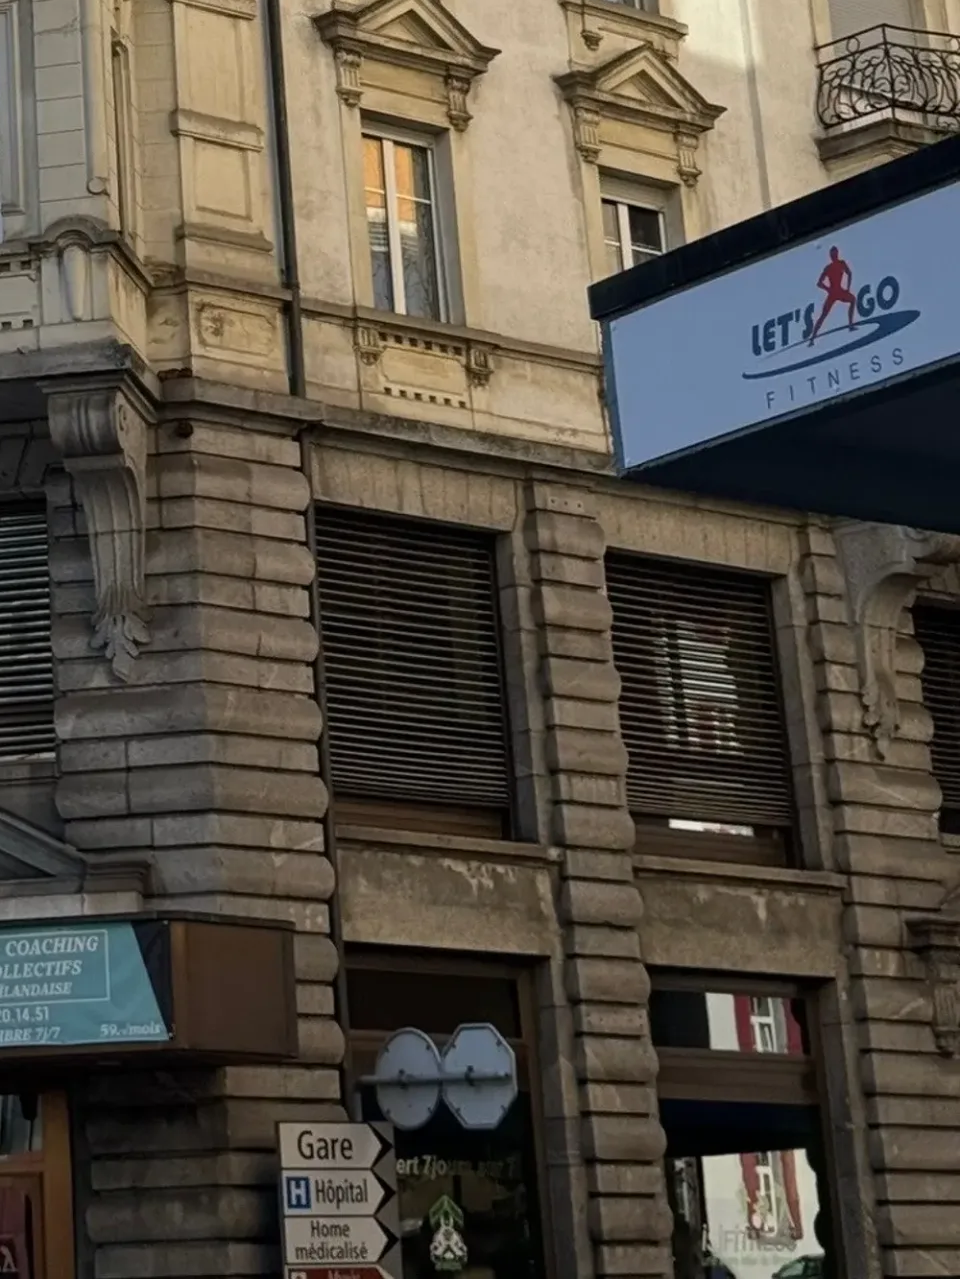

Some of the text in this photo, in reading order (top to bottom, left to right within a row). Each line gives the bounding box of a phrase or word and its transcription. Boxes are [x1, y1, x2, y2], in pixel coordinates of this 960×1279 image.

[752, 276, 899, 357] LET'S GO
[765, 347, 904, 409] FITNESS
[5, 935, 99, 957] COACHING
[297, 1129, 354, 1161] Gare
[314, 1178, 369, 1209] Hôpital
[310, 1221, 351, 1238] Home
[295, 1239, 369, 1261] médicalisé
